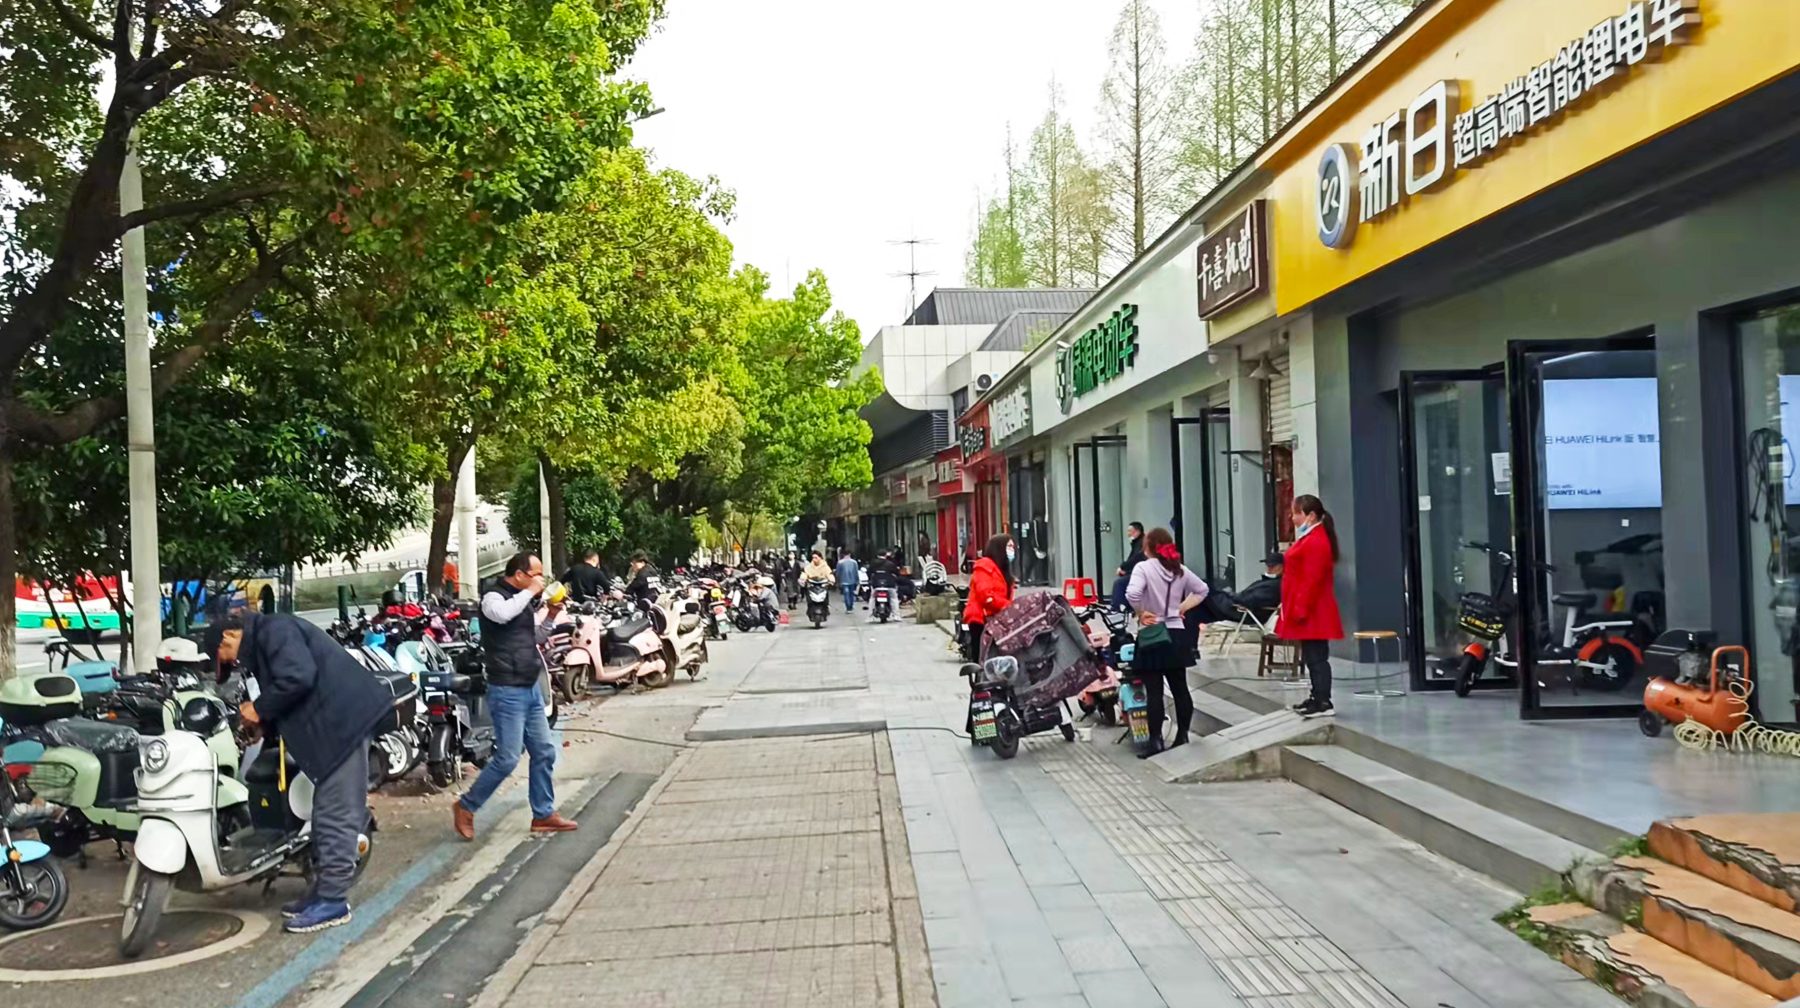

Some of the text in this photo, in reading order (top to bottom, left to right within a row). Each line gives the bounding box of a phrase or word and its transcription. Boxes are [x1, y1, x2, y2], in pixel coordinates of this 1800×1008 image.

[1359, 0, 1687, 223] 新日 超高端智能锂电车
[1556, 434, 1594, 444] HUAWEI
